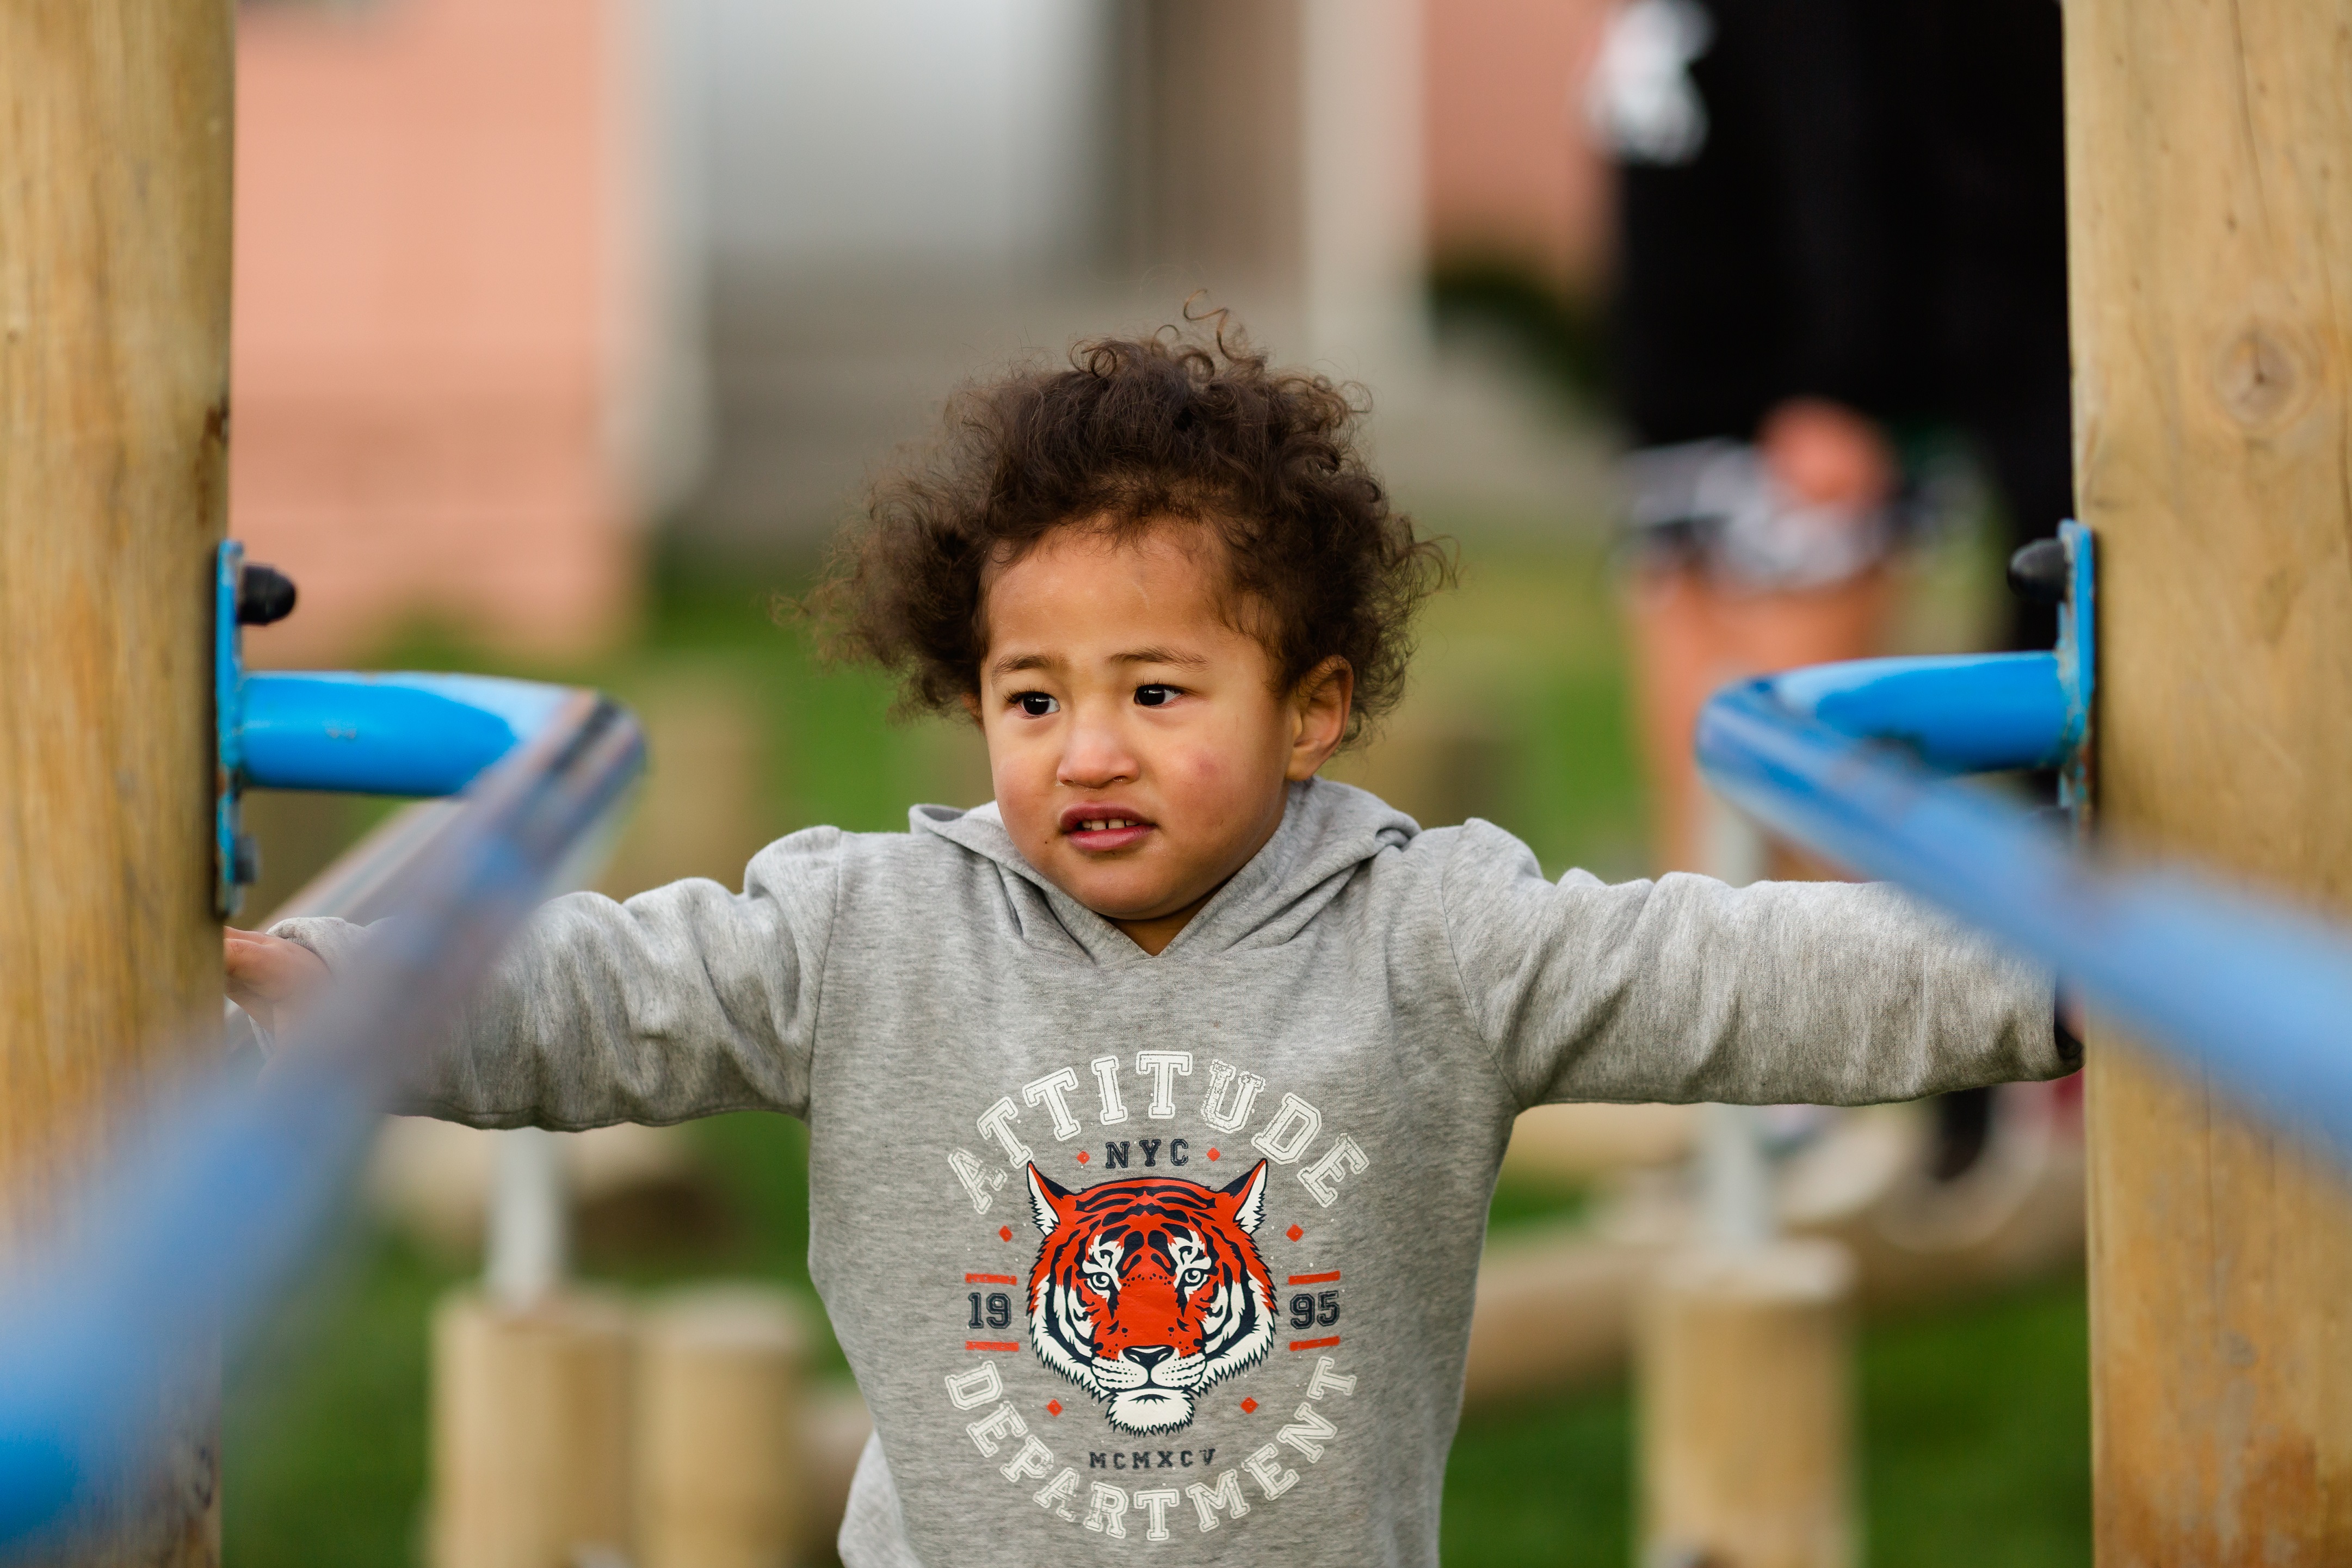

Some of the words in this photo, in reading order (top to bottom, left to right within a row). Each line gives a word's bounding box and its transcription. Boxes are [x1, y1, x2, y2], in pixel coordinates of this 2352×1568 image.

[947, 1051, 1370, 1214] ATTITUDE
[1105, 1139, 1189, 1169] NYC
[967, 1292, 1012, 1329] 19
[1289, 1291, 1340, 1330] 95
[944, 1356, 1357, 1541] DEPARTMENT
[1089, 1448, 1215, 1470] MCMXCV
